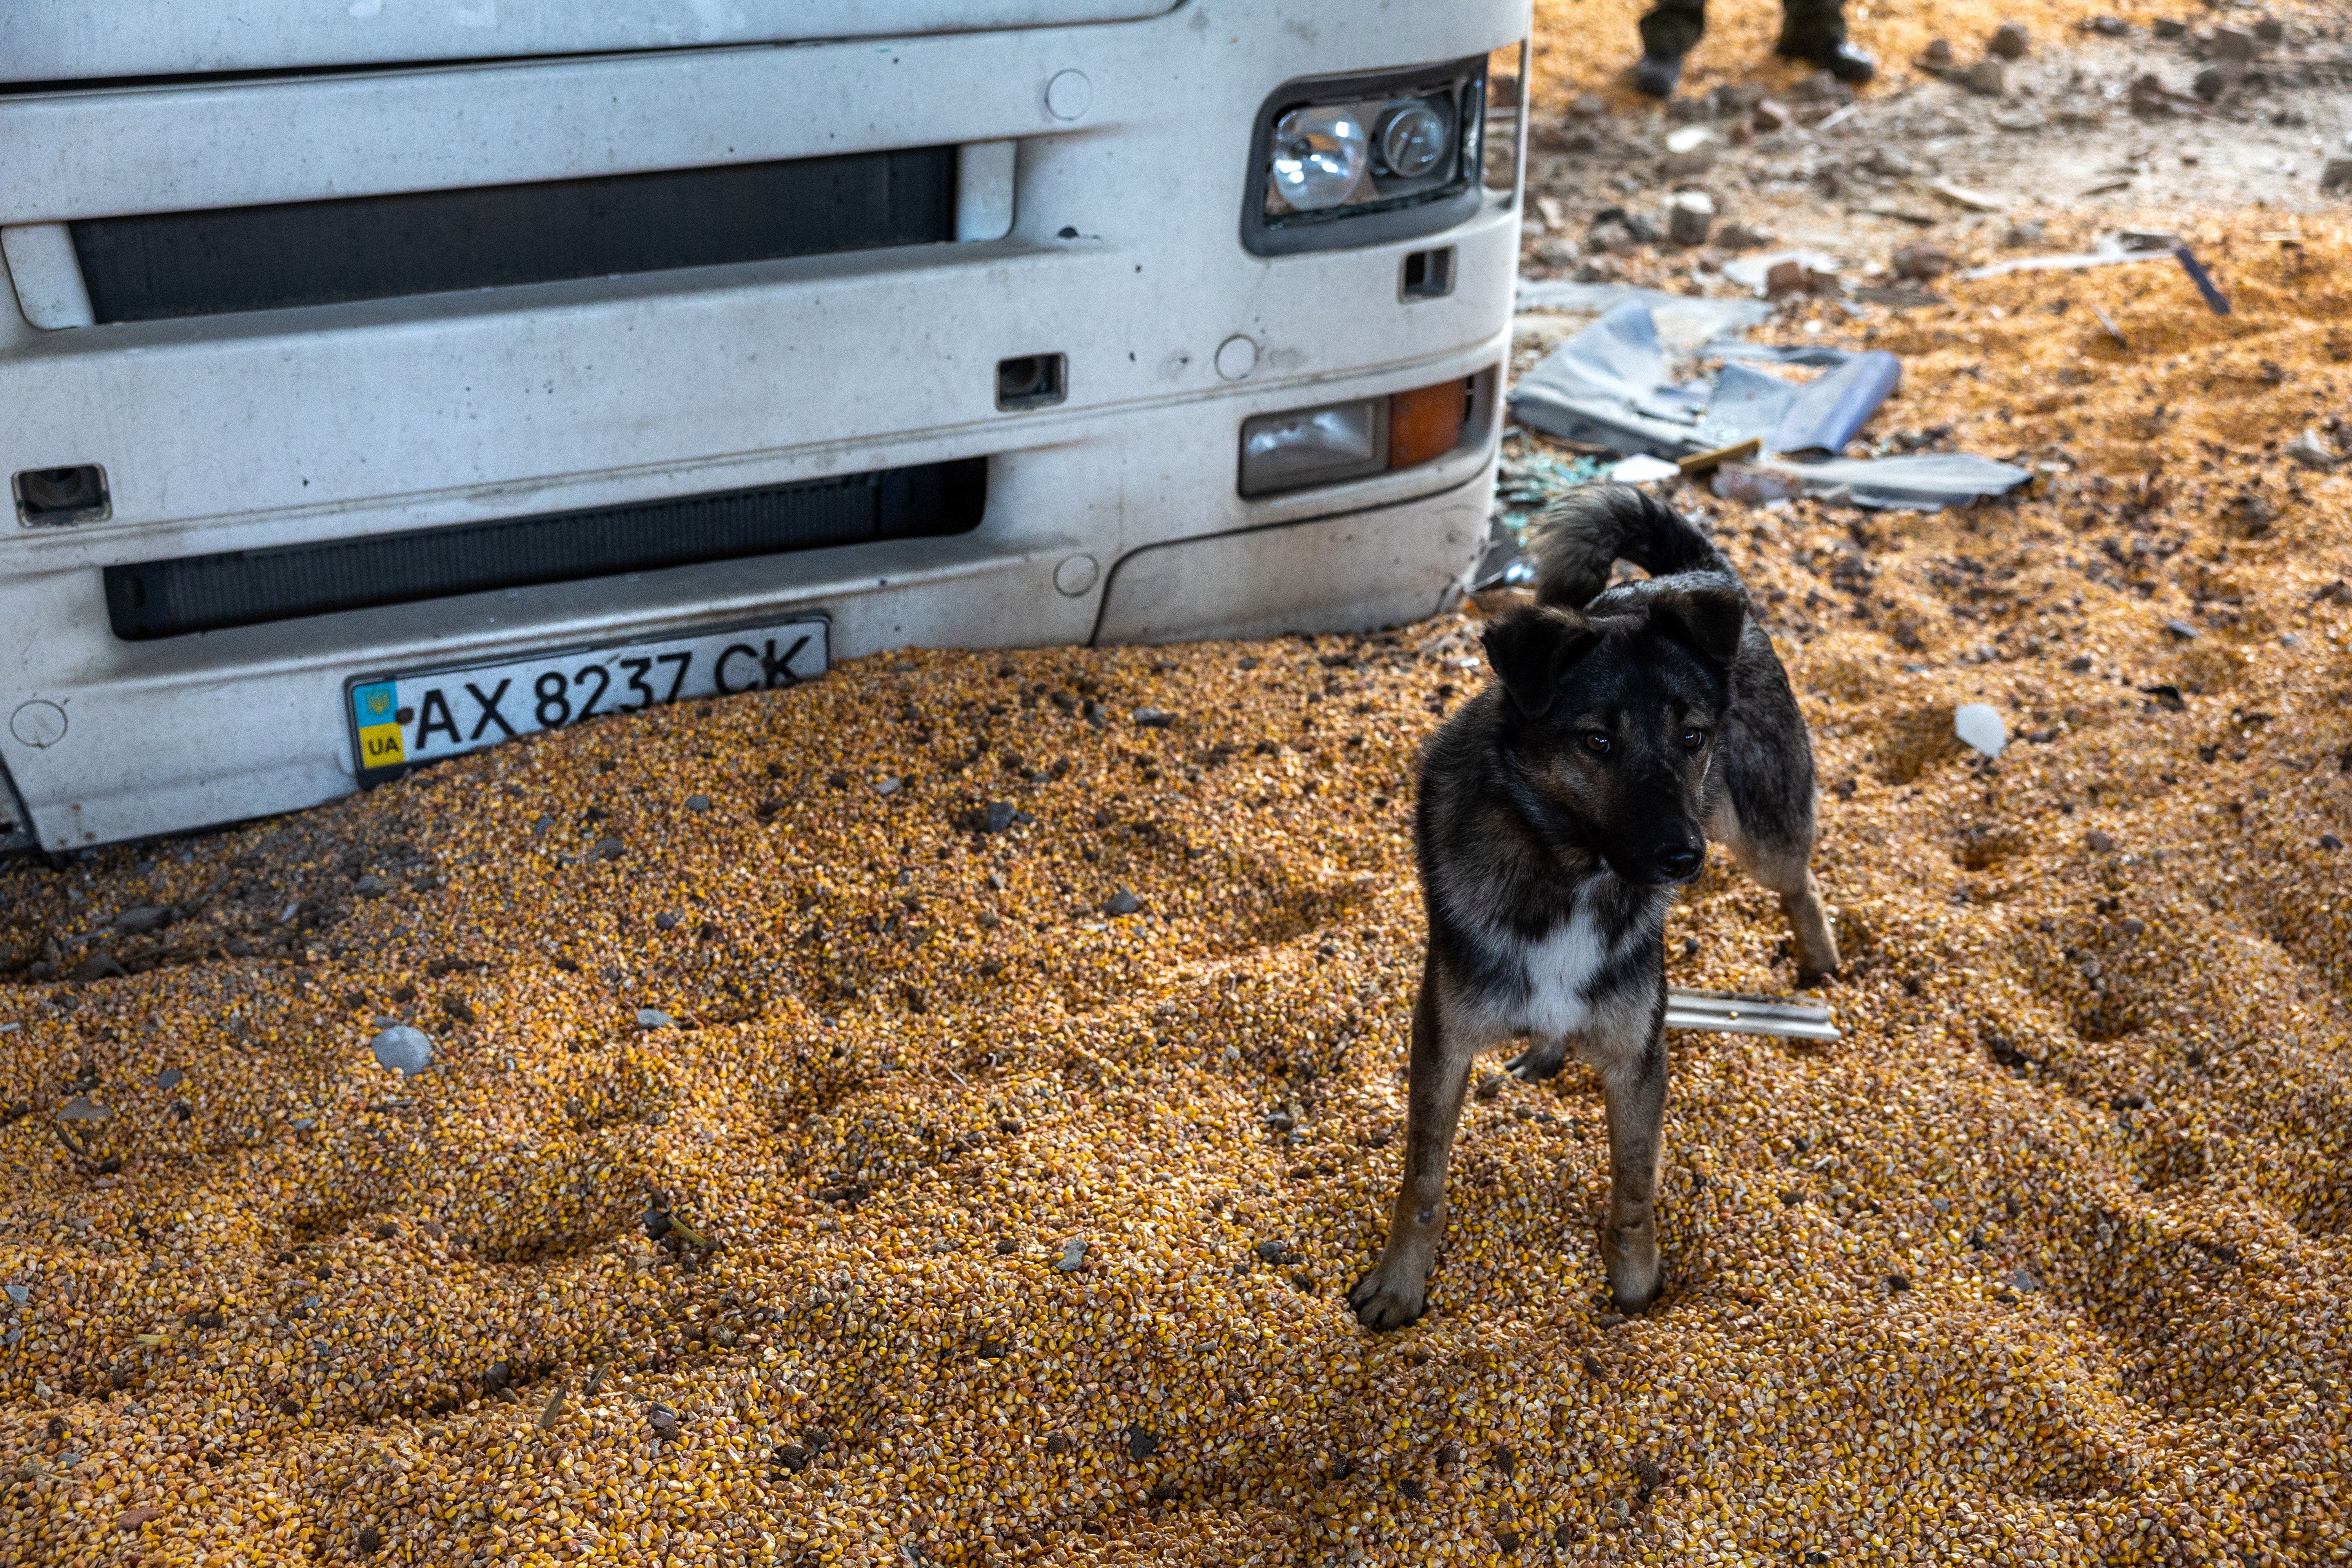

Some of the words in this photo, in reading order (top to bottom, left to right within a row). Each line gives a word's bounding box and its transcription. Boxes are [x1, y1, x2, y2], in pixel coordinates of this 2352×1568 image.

[416, 679, 517, 750] AX
[535, 652, 692, 728] 8237
[715, 636, 810, 694] CK
[369, 737, 399, 756] UA
